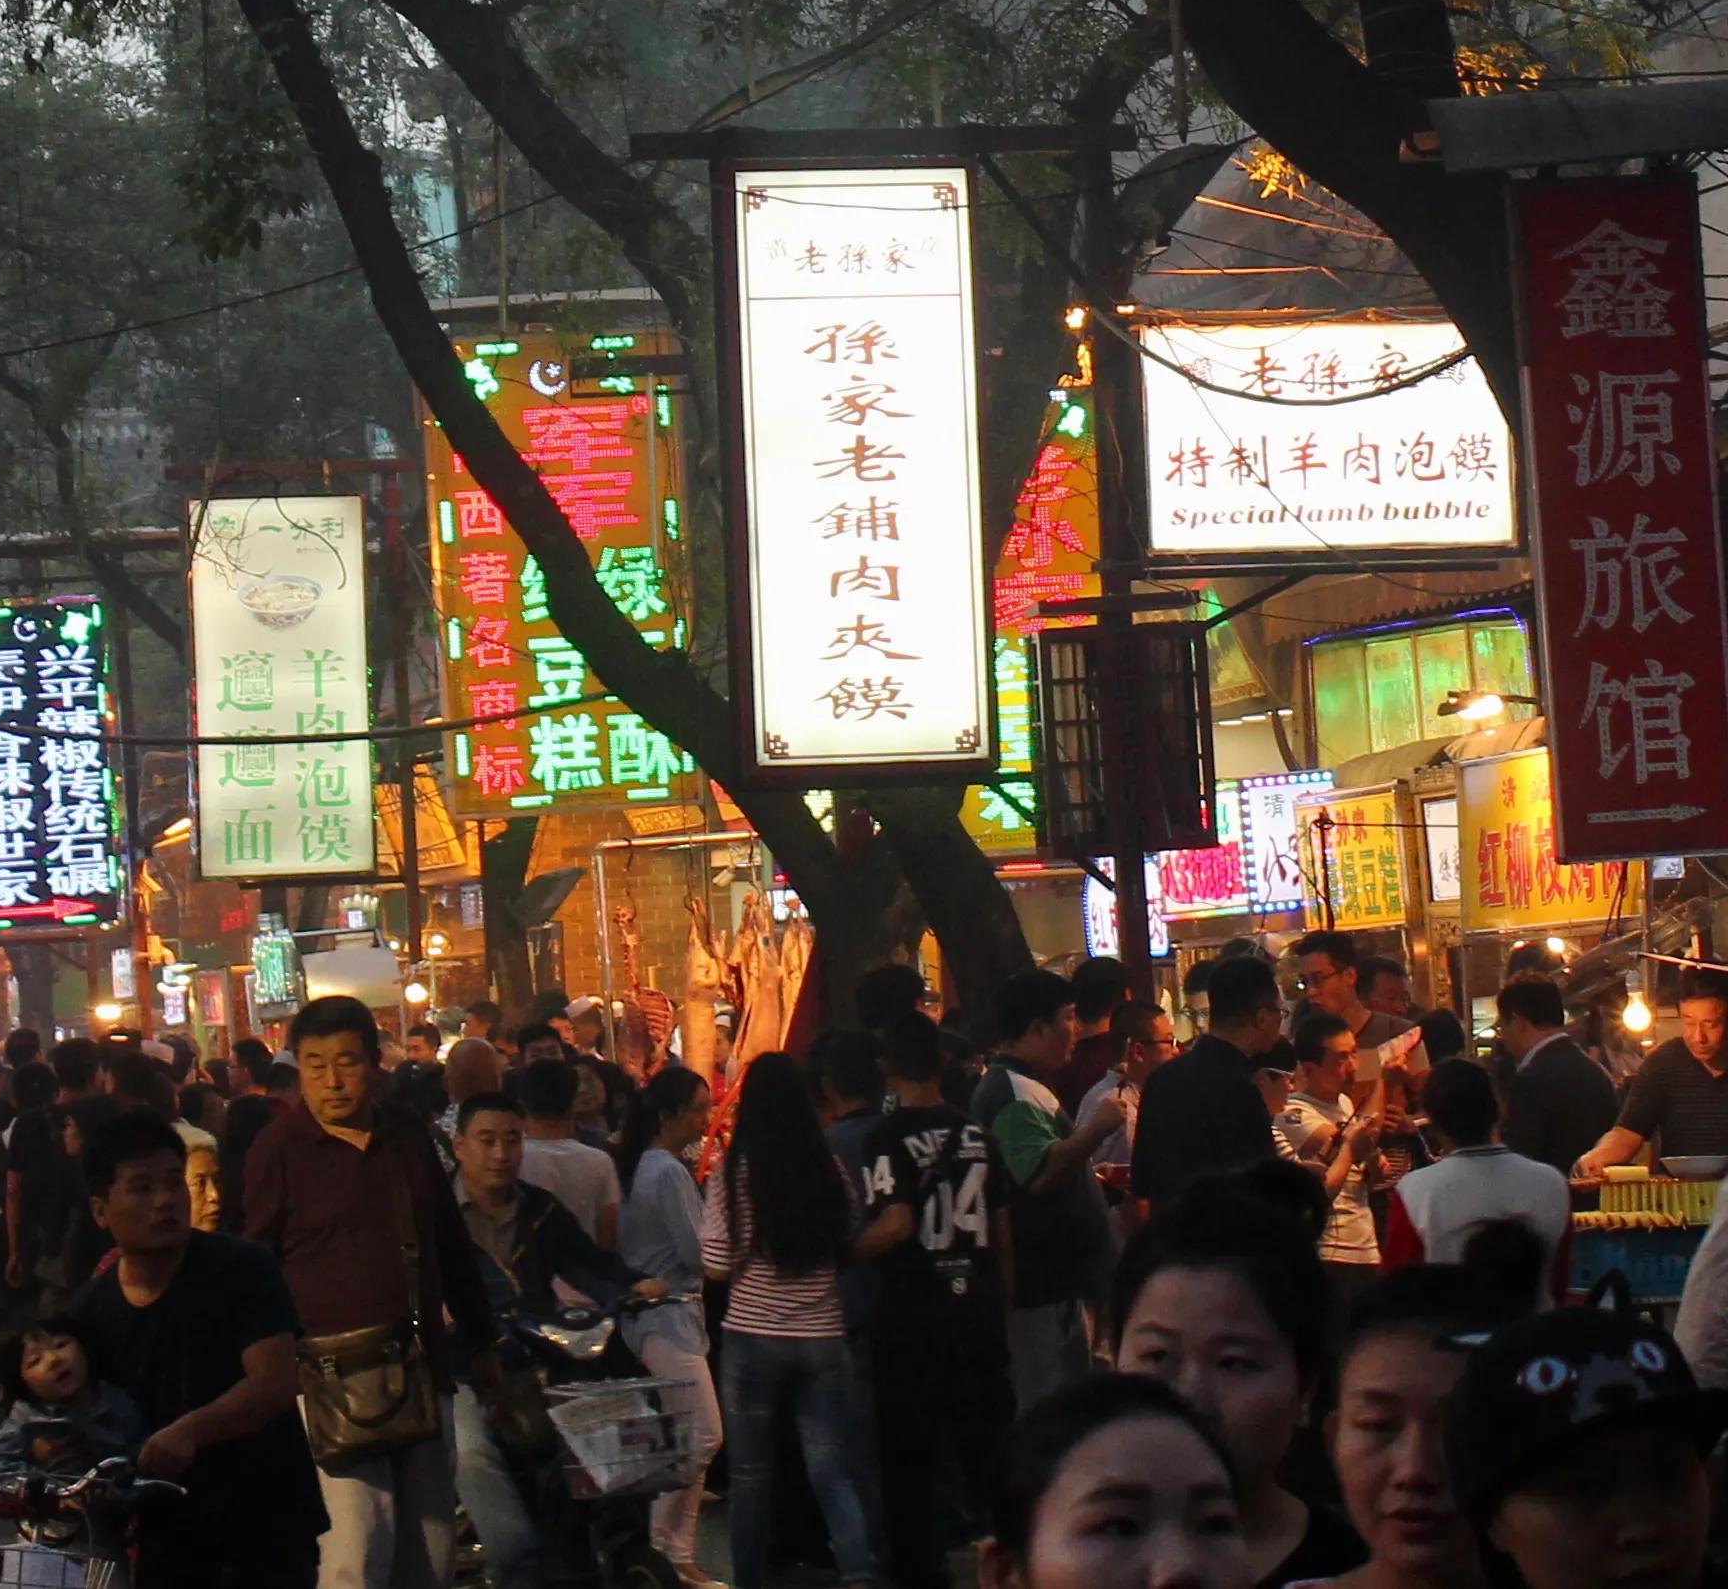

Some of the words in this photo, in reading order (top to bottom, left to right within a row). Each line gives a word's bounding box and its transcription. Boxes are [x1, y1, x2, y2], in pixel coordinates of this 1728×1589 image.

[1171, 504, 1289, 529] Special
[1296, 499, 1374, 523] lamb
[1382, 499, 1491, 522] bubble
[1552, 218, 1696, 785] 鑫源旅馆
[453, 454, 527, 796] 西著名商标
[595, 546, 682, 786] 绿酥
[291, 648, 353, 864] 羊肉泡馍
